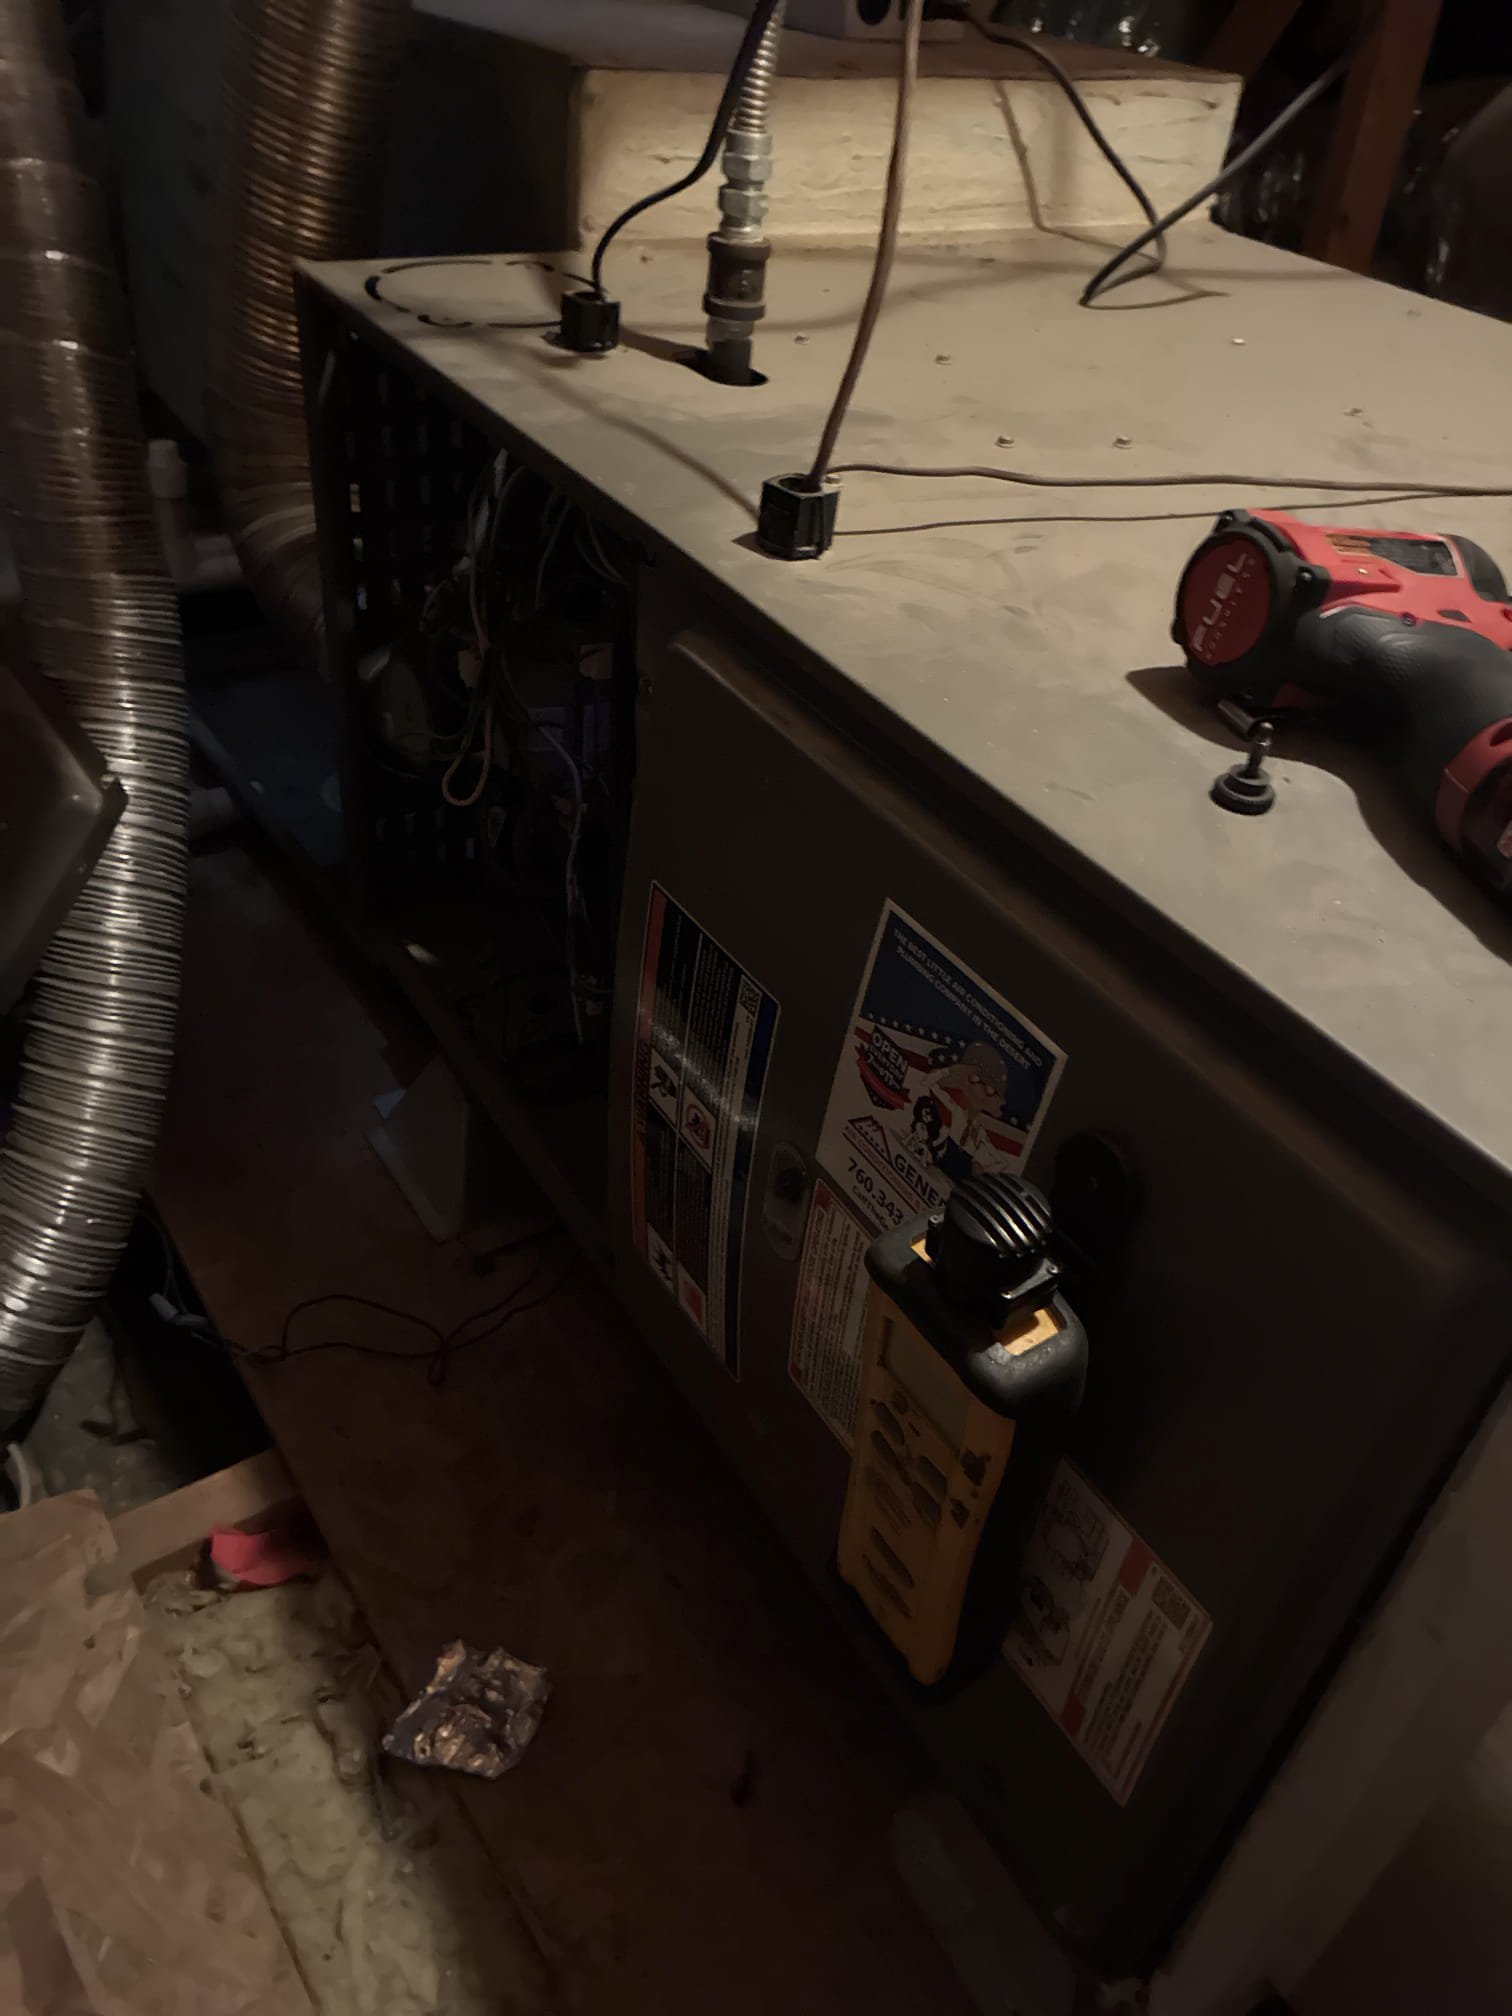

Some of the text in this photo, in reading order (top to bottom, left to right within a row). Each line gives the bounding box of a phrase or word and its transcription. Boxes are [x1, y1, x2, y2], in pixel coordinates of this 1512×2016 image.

[1191, 553, 1247, 652] FUEL
[872, 1032, 908, 1073] OPEN
[847, 1157, 904, 1226] 760.343
